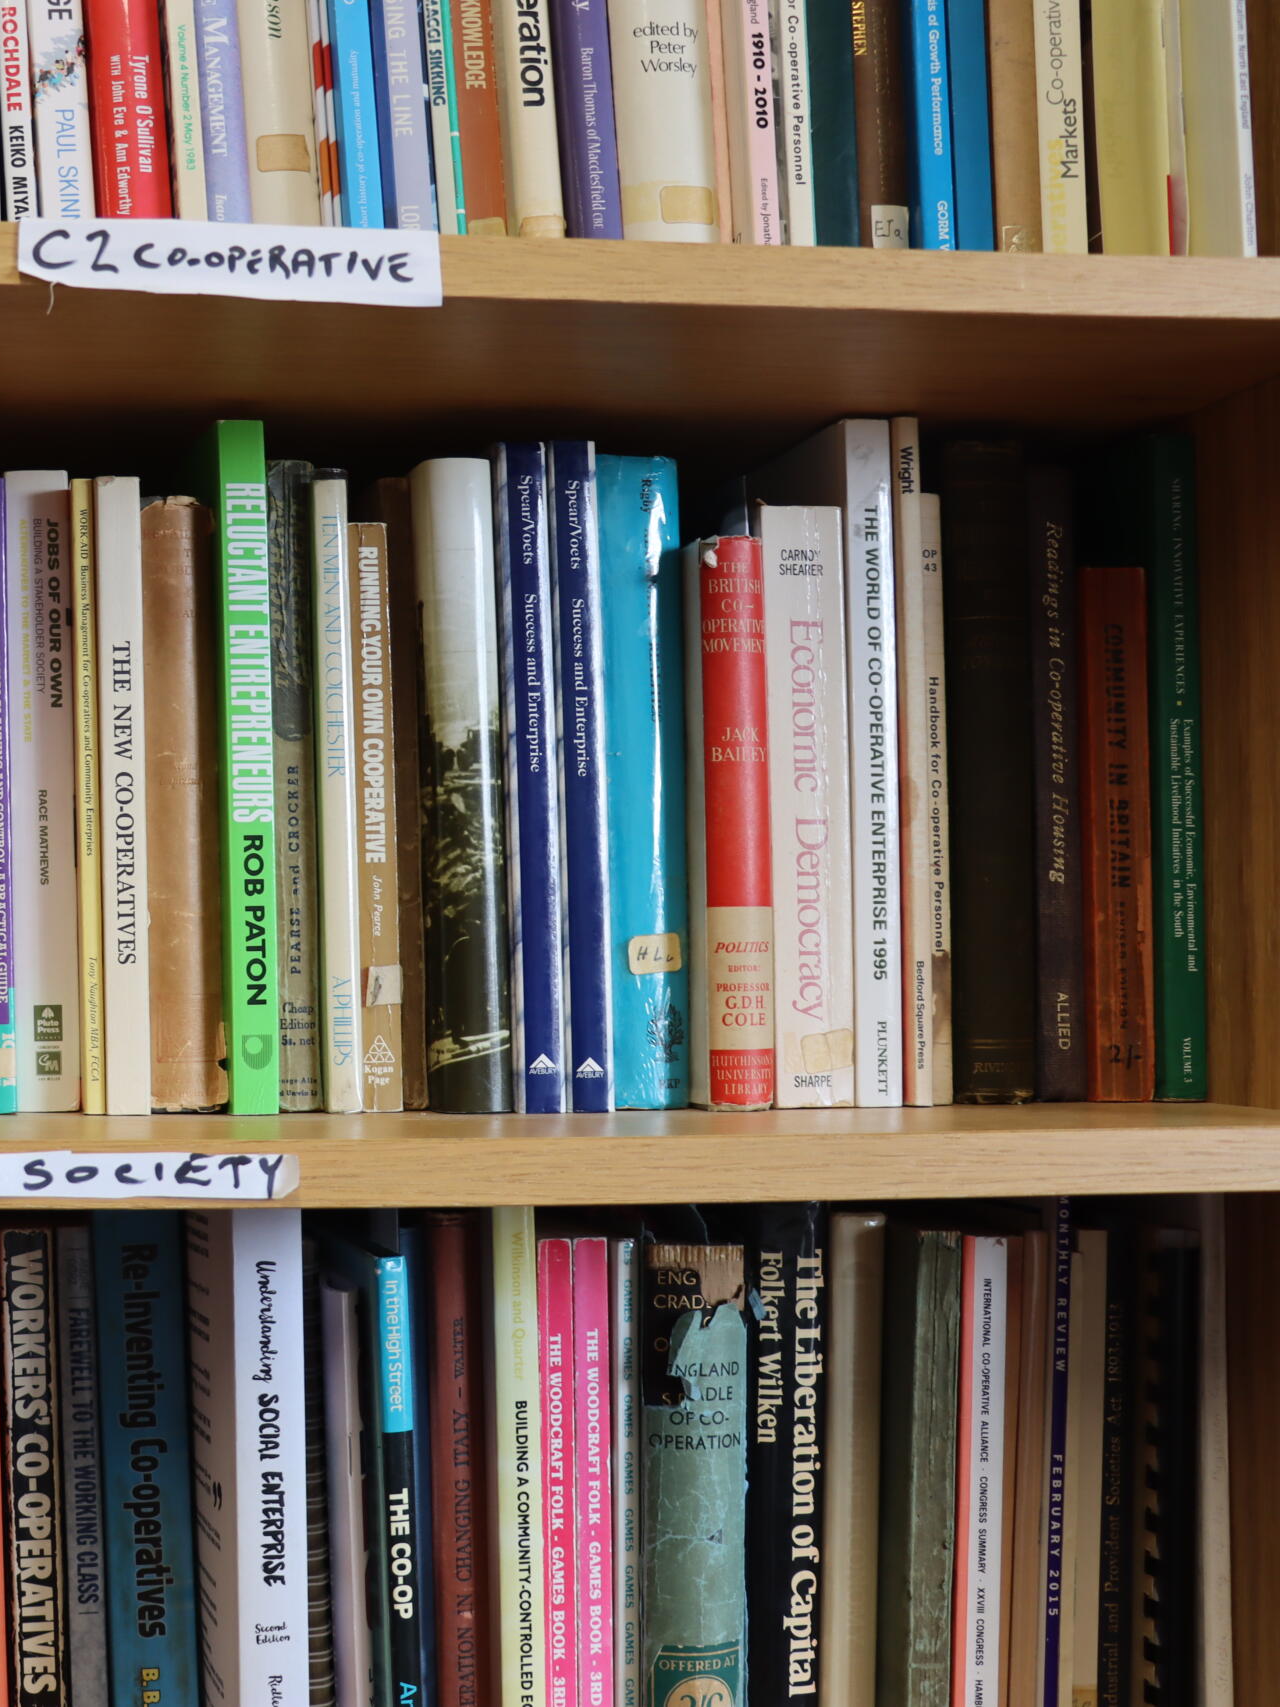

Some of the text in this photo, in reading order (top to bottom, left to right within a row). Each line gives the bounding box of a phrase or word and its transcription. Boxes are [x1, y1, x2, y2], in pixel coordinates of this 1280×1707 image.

[633, 23, 698, 40] edited by
[641, 58, 697, 77] Worsley
[650, 40, 685, 55] Peter
[752, 32, 765, 69] 1910
[1, 6, 26, 168] ROCHDALE KEIKO
[112, 80, 123, 102] John
[113, 107, 124, 125] Eve
[128, 55, 153, 172] Tyrone O'Sullivan
[203, 17, 229, 154] MANAGEMENT
[391, 50, 413, 137] THE LINE
[430, 50, 446, 107] SIKKING
[754, 88, 768, 129] 2010
[787, 16, 806, 185] Co-operative Personnel
[56, 109, 75, 159] PAUL
[115, 143, 128, 161] Ann
[581, 47, 605, 229] Baron Thomas of Macclesfield CBE
[1061, 98, 1078, 179] Markets
[117, 166, 130, 215] Edworthy
[133, 243, 414, 283] CO-OPERATIVE
[47, 518, 63, 708] JOBS OF OUR OWN
[226, 483, 273, 822] RELUCTANT ENTREPRENEURS
[524, 593, 541, 773] Success and Enterprise
[864, 506, 888, 981] THE WORLD OF CO-OPERATIVE ENTERPRISE 1995
[112, 641, 136, 965] THE NEW CO-OPERATIVES
[243, 835, 267, 1006] ROB PATON
[714, 941, 769, 953] POLITICS
[722, 1013, 766, 1027] COLE
[877, 1021, 888, 1095] PLUNKETT
[1056, 992, 1071, 1050] ALLIED
[794, 1076, 832, 1088] SHARPE
[23, 1153, 284, 1199] SOCIETY
[757, 1250, 783, 1444] Folkert Wilken
[979, 1278, 992, 1462] INTERNATIONAL CO-OPERATIVE ALLIANCE
[253, 1260, 285, 1588] Understanding SOCIAL ENTERPRISE
[9, 1249, 56, 1695] WORKERS' CO-OPERATIVES
[783, 1248, 824, 1698] The Liberation of Capital
[388, 1488, 413, 1619] THE CO-OP
[977, 1476, 988, 1574] CONGRESS SUMMARY
[1049, 1454, 1063, 1616] FEBRUARY 2015
[255, 1622, 287, 1634] Second
[256, 1634, 290, 1645] Edition
[659, 1655, 736, 1673] OFFERED AT
[975, 1587, 985, 1666] XXVIII CONGRESS
